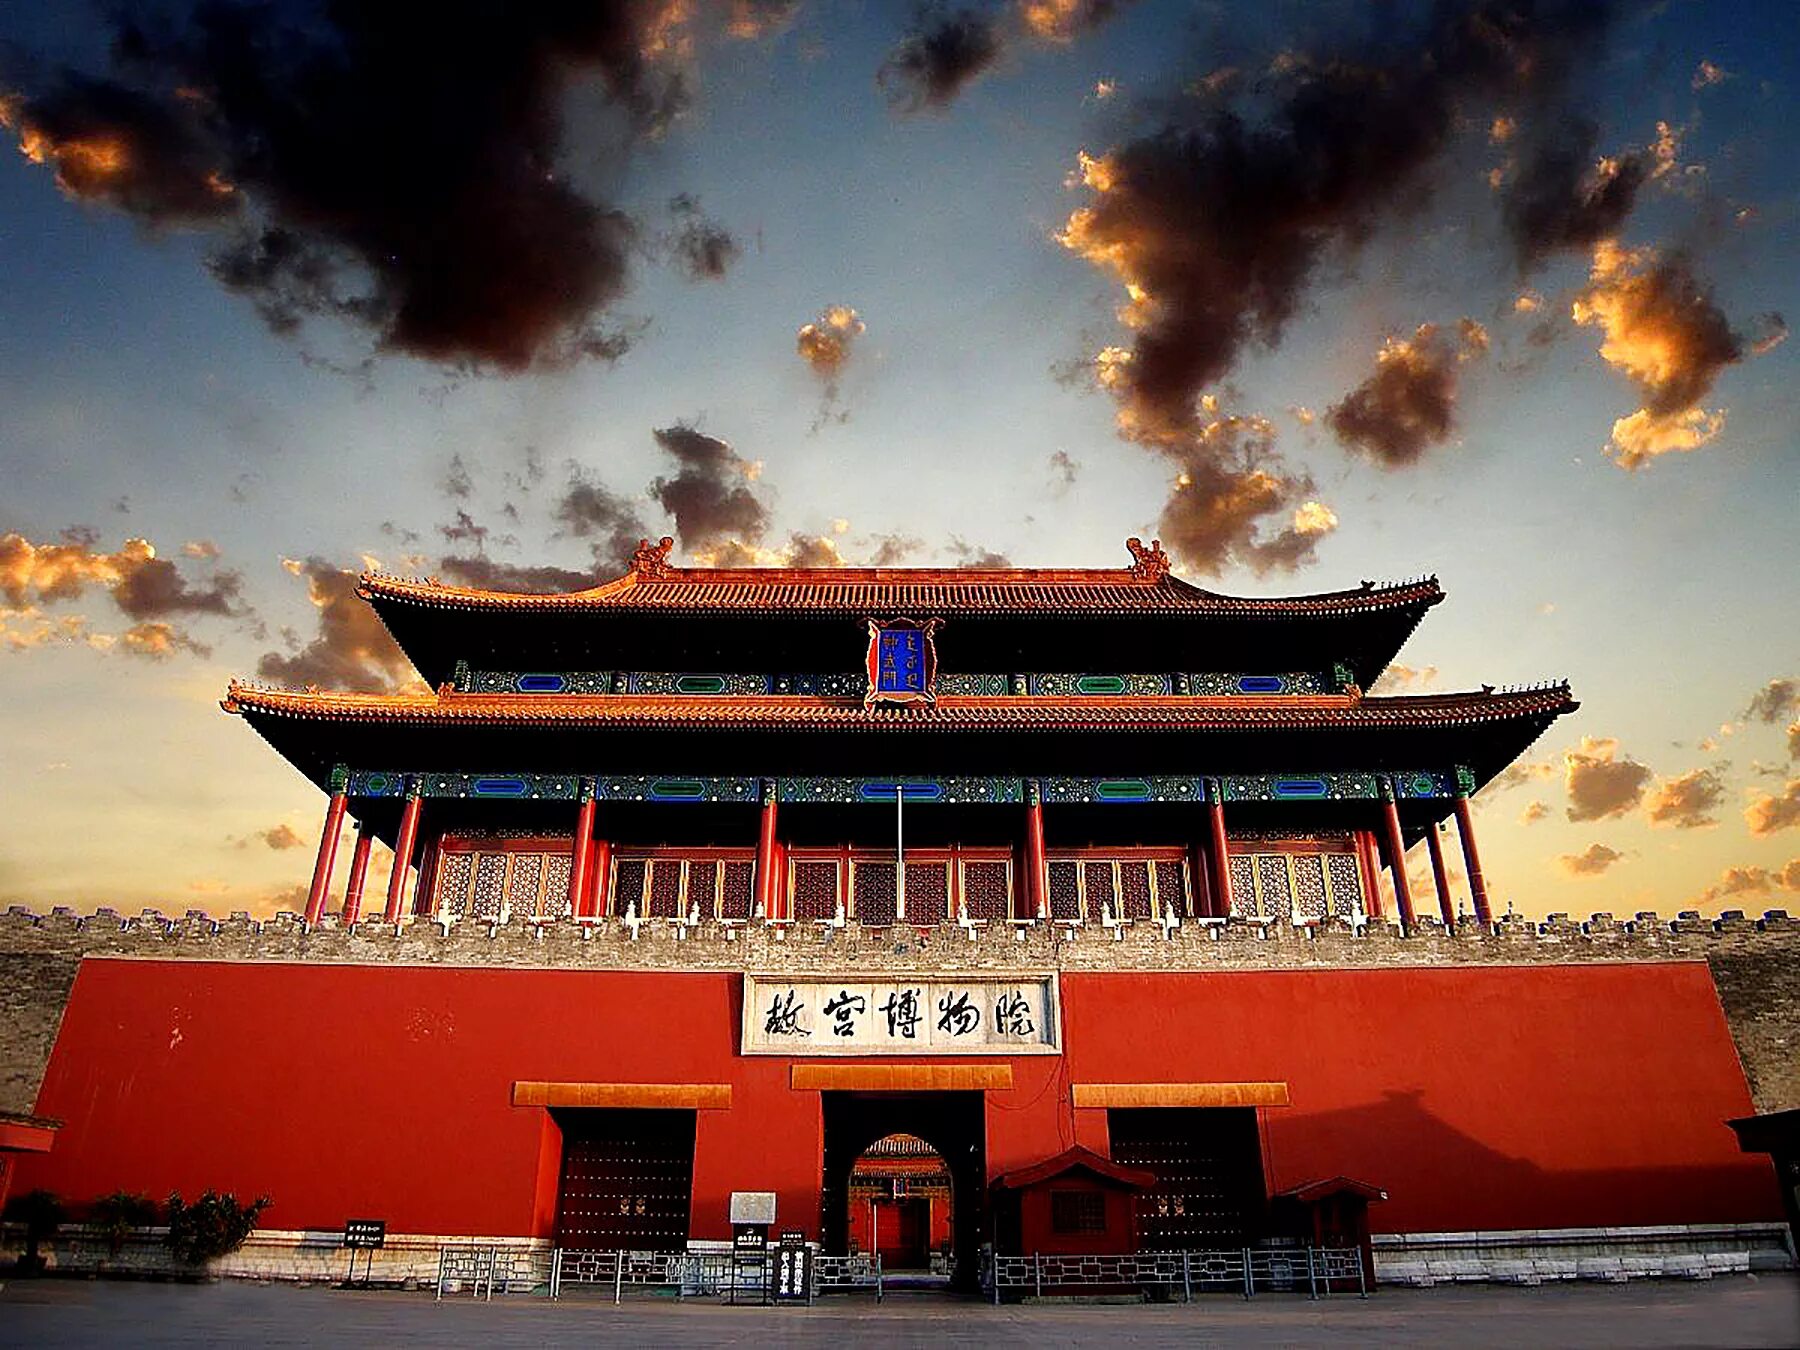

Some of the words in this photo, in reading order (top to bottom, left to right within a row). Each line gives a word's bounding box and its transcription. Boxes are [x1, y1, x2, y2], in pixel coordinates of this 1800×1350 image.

[764, 989, 1034, 1038] 故宫博物院
